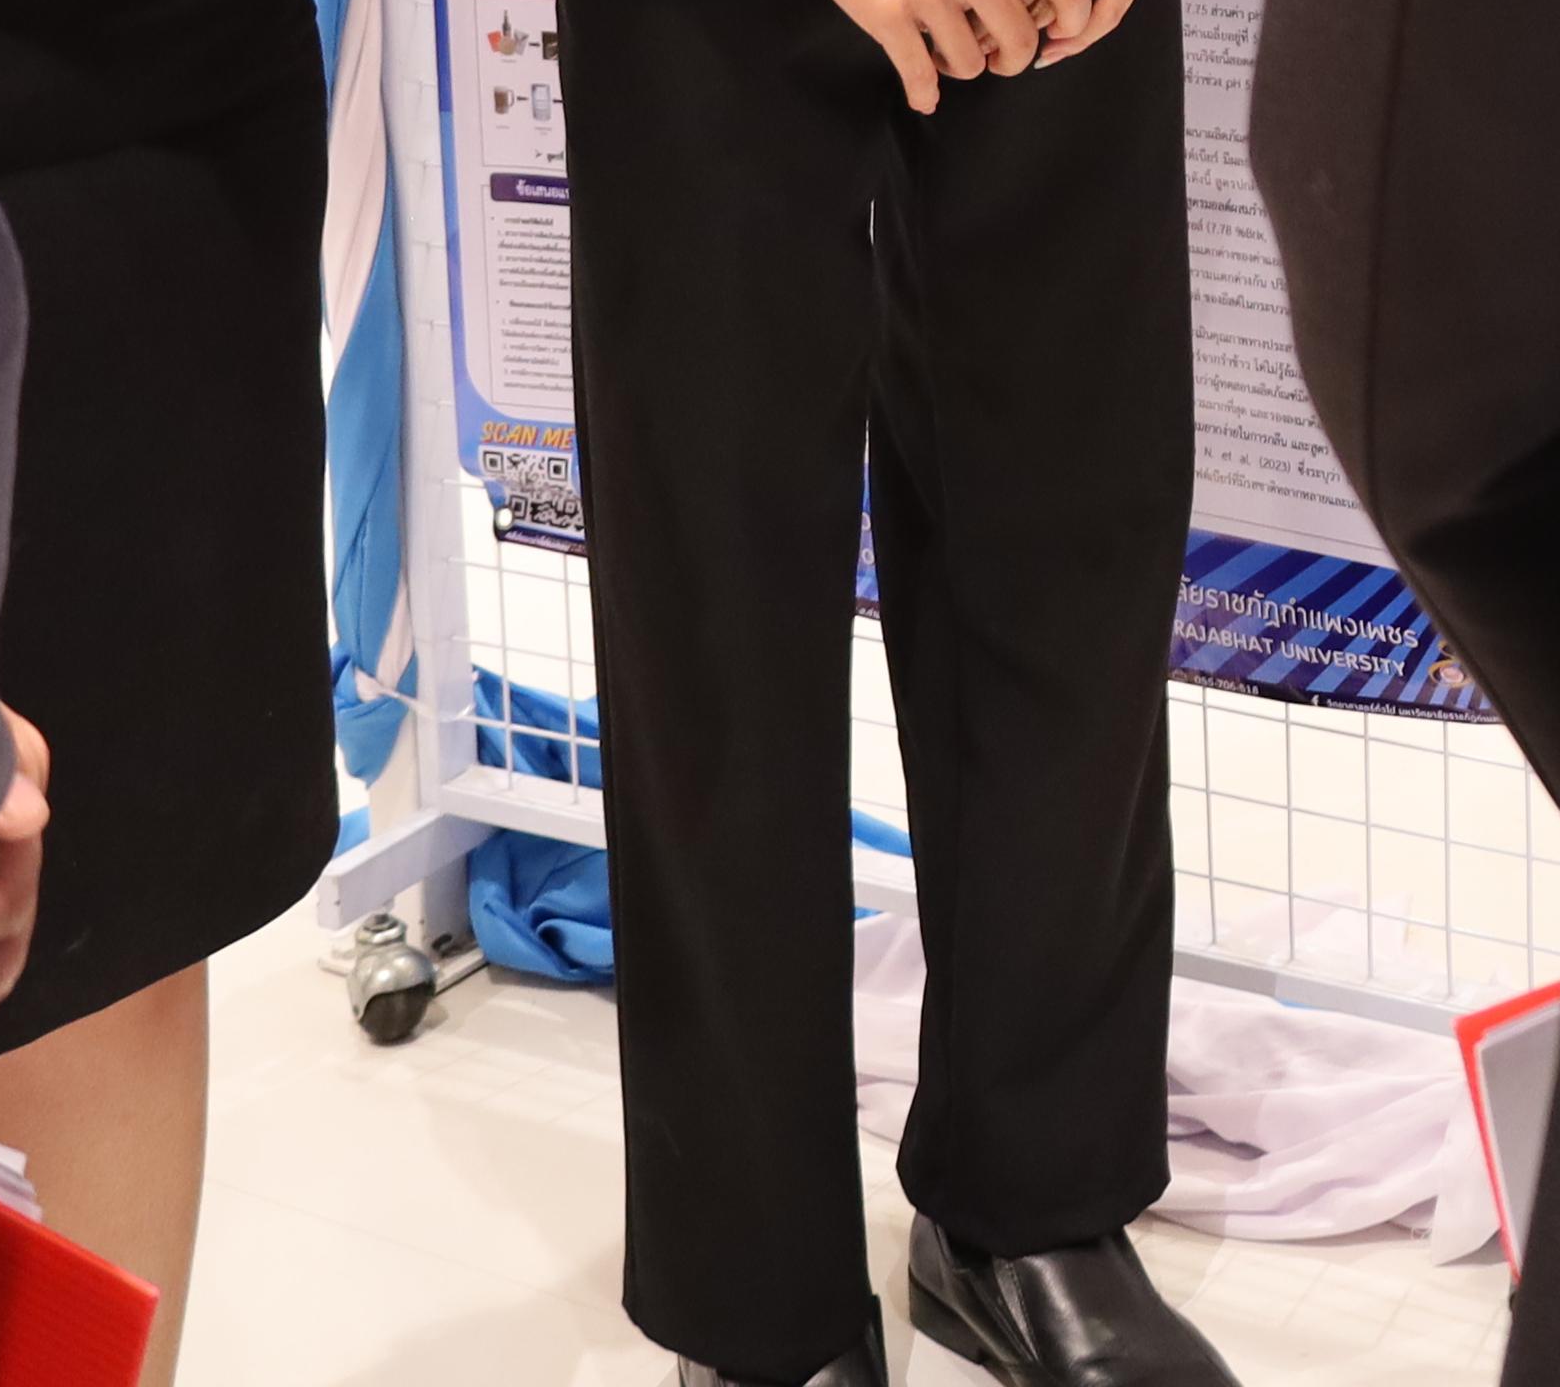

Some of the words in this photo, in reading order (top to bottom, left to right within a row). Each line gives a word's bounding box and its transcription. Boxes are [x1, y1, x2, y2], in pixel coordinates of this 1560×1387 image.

[481, 421, 538, 446] SCAN
[542, 427, 576, 451] ME
[1259, 457, 1292, 473] (2023)
[1173, 618, 1274, 655] RAJABHAT
[1280, 640, 1406, 677] UNIVERSITY
